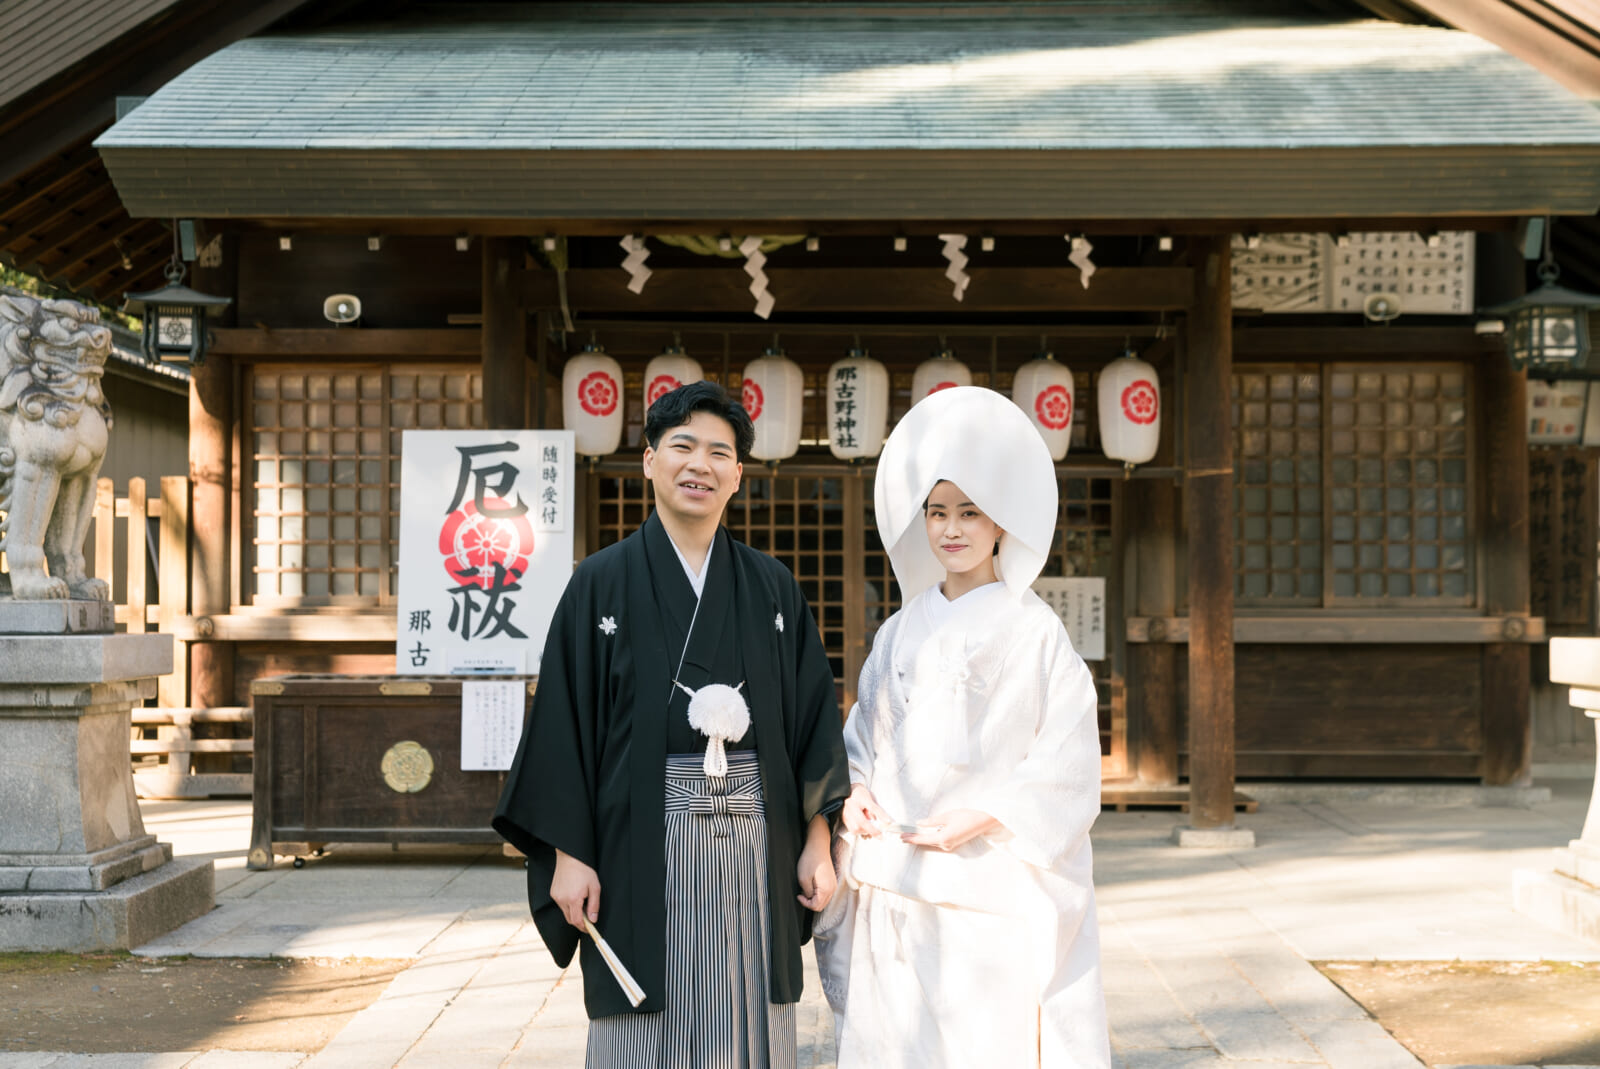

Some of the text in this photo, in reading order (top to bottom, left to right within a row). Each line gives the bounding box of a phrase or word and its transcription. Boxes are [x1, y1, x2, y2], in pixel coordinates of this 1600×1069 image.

[834, 366, 858, 448] 那古野神社
[542, 445, 558, 524] 随時受付
[445, 441, 529, 641] 厄祓
[408, 609, 432, 667] 那古
